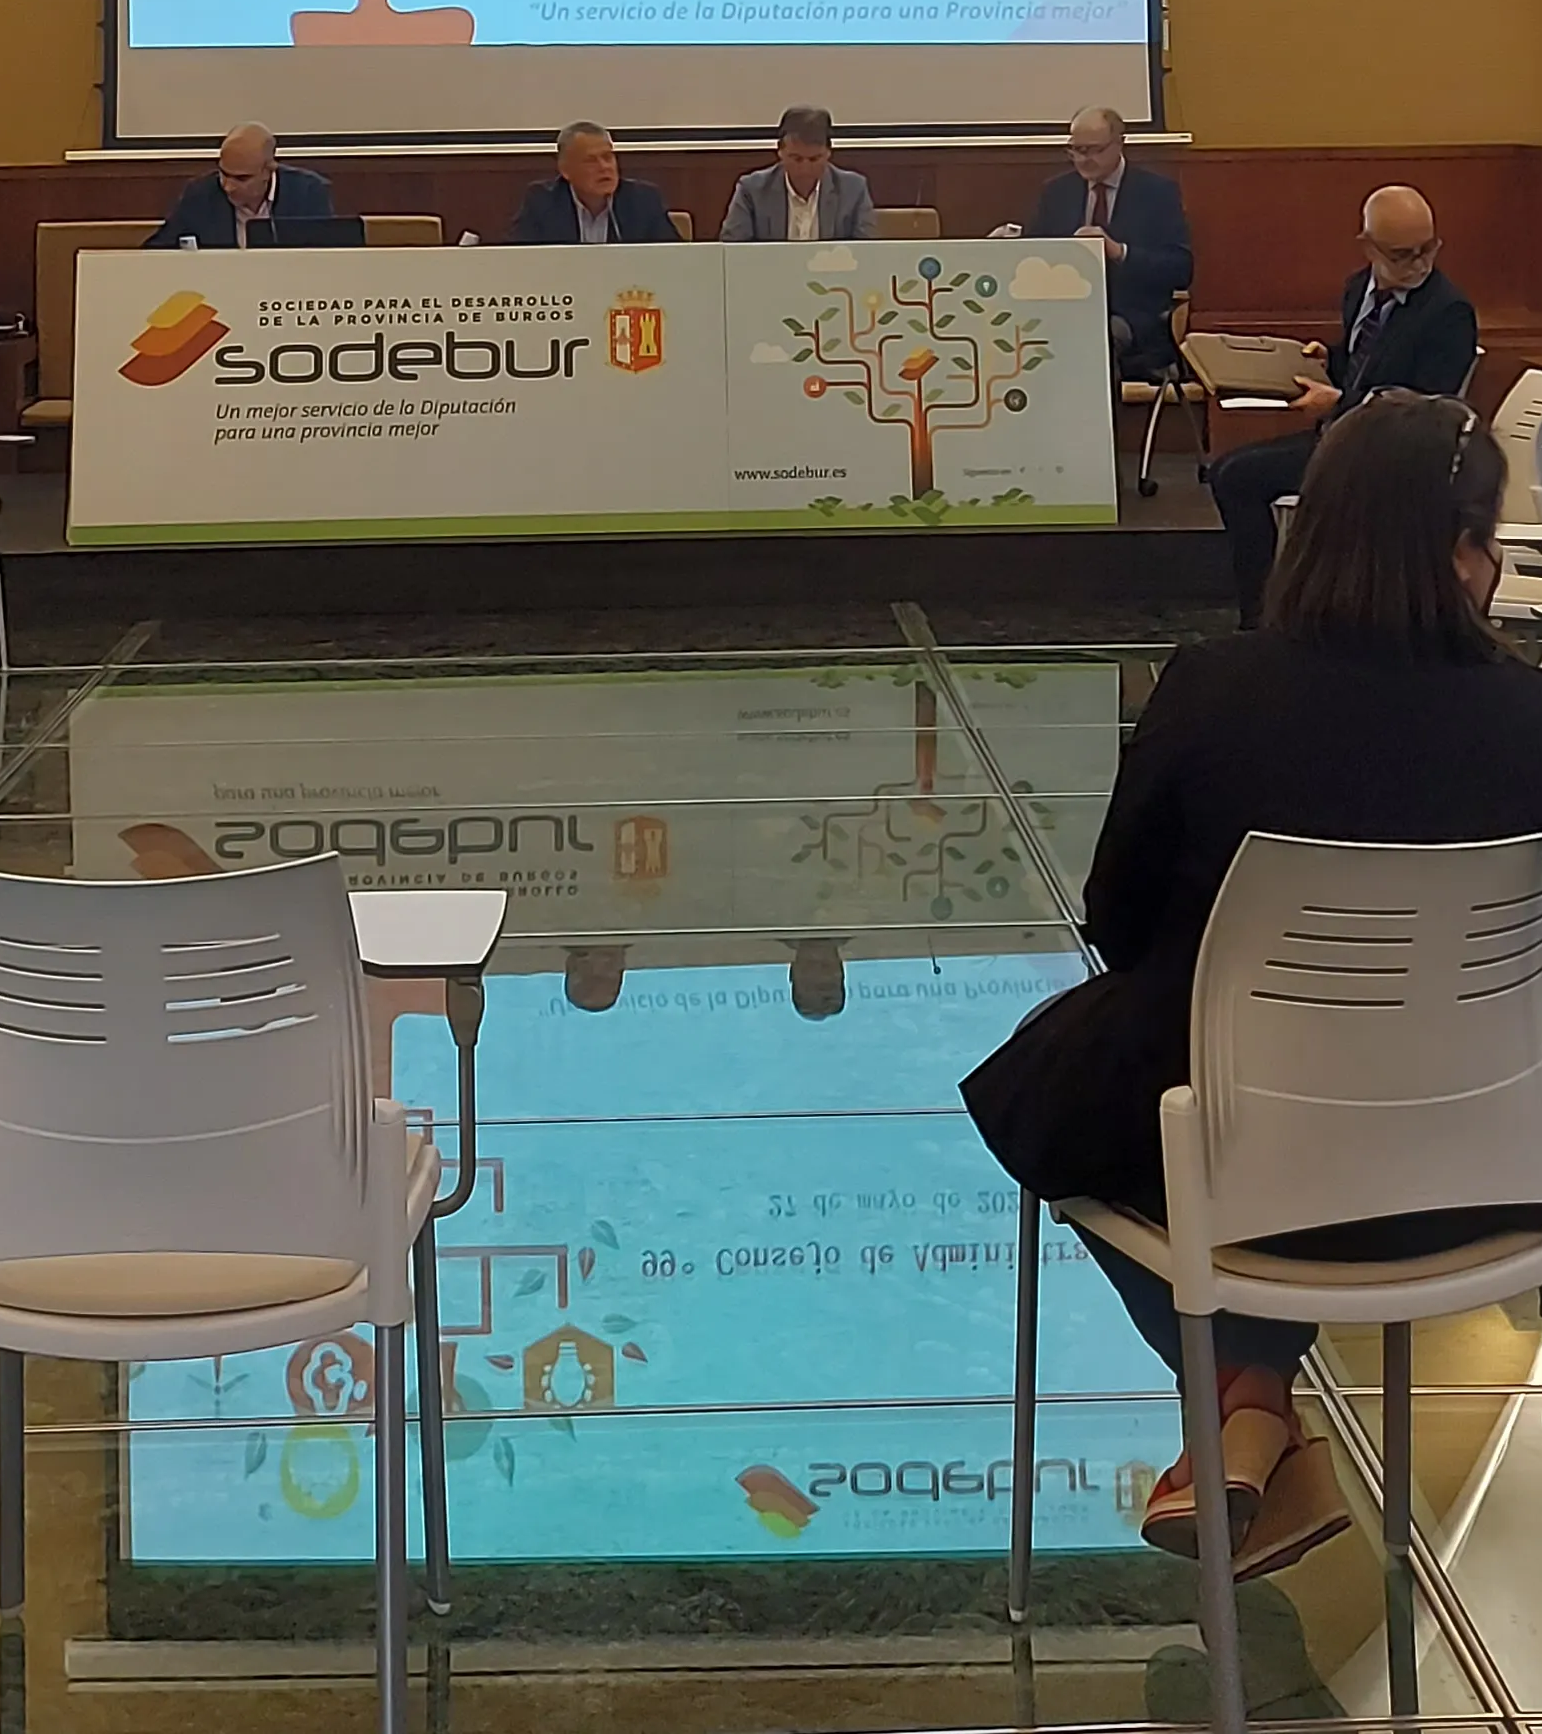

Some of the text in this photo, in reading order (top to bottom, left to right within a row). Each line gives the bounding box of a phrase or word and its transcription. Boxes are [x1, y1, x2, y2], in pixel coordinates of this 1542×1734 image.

[575, 2, 657, 21] servicio
[662, 1, 688, 21] de
[695, 1, 715, 20] la
[721, 1, 839, 24] Diputación
[842, 5, 892, 23] para
[899, 4, 940, 20] una
[945, 1, 1047, 21] Provincia
[258, 294, 574, 313] SOCIEDAD PARA EL DESARROLLO
[258, 309, 575, 327] DE LA PROVINCIA DE BURGOS
[214, 330, 591, 386] sodebur
[215, 396, 517, 423] Un mejor servicio de la Diputación
[214, 420, 441, 445] para una provincia mejor
[734, 465, 847, 481] www.sodebur.es
